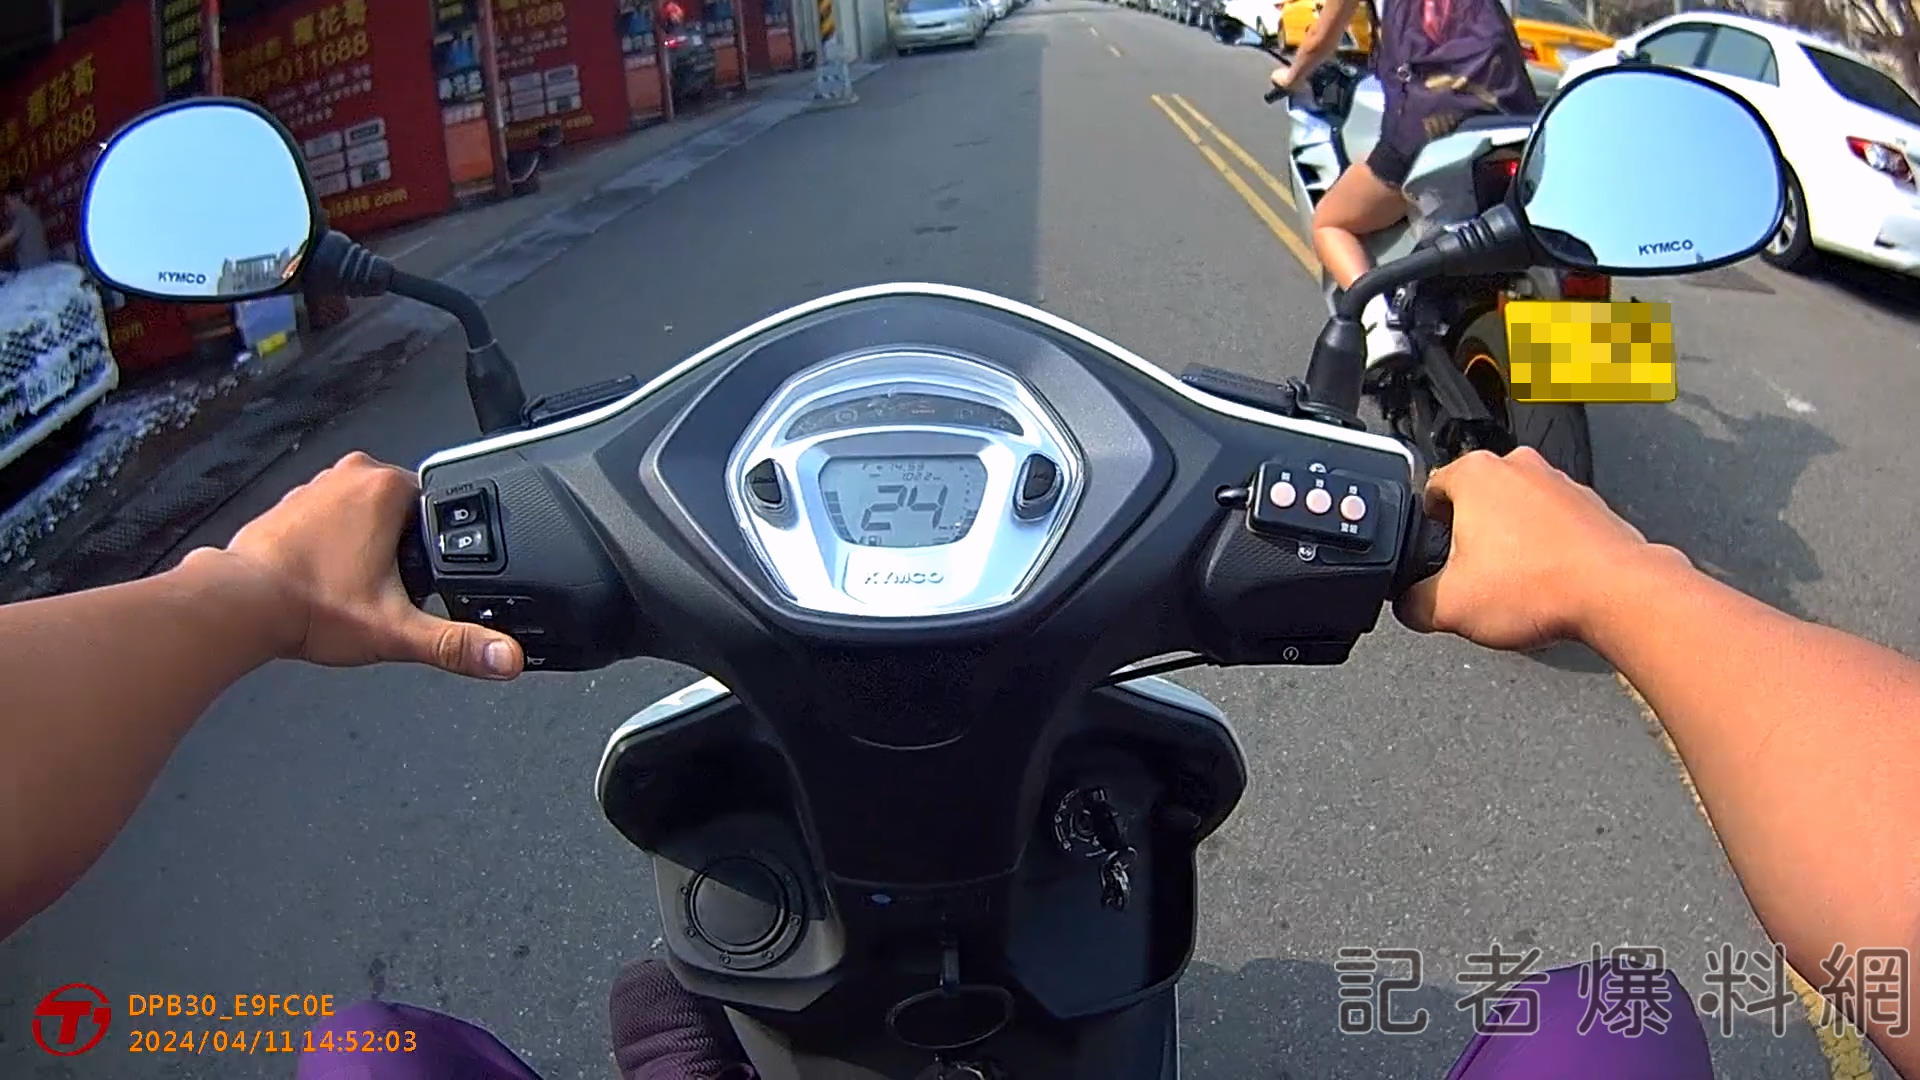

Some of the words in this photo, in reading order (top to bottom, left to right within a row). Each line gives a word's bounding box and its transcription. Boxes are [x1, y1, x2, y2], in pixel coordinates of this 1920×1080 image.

[1637, 238, 1694, 256] KYMCO
[158, 271, 207, 285] KYMCO
[860, 484, 948, 532] 24
[864, 571, 944, 584] KYMCO
